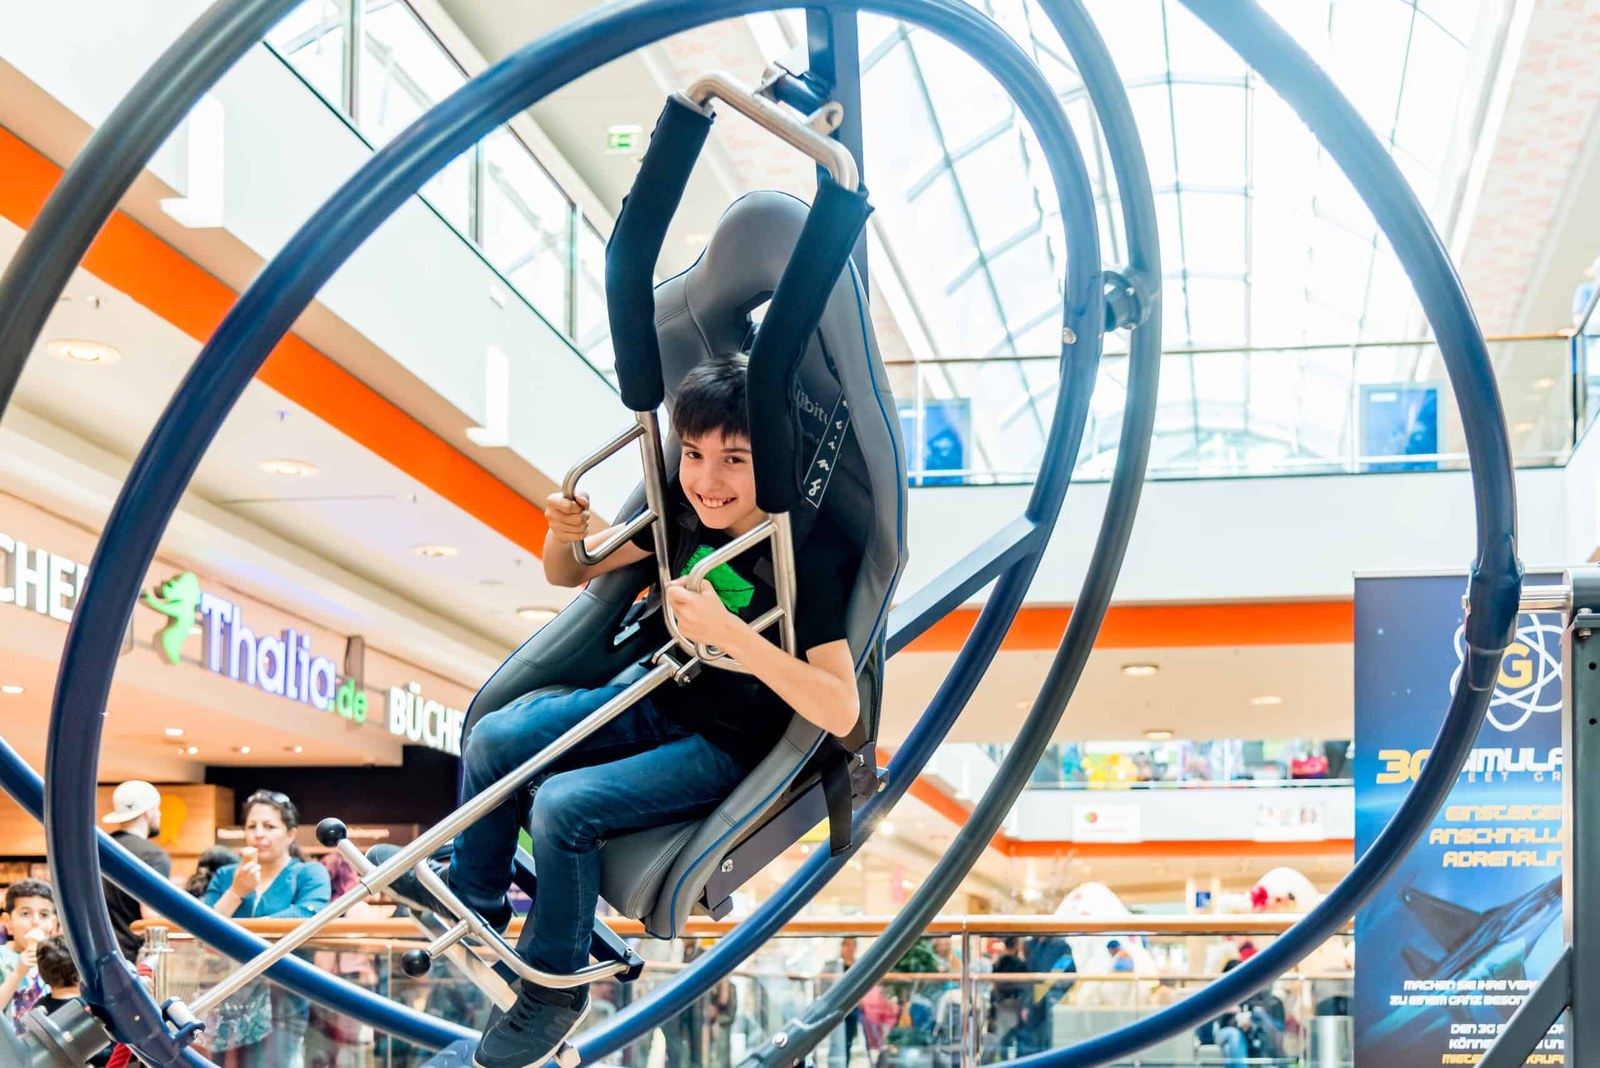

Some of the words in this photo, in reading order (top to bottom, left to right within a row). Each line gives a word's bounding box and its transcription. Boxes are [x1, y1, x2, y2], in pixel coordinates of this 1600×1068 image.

[1462, 747, 1562, 773] IMULA
[1457, 772, 1509, 783] EET
[1445, 804, 1562, 822] EINSTEIGE
[1429, 828, 1562, 845] ANSCHNALL
